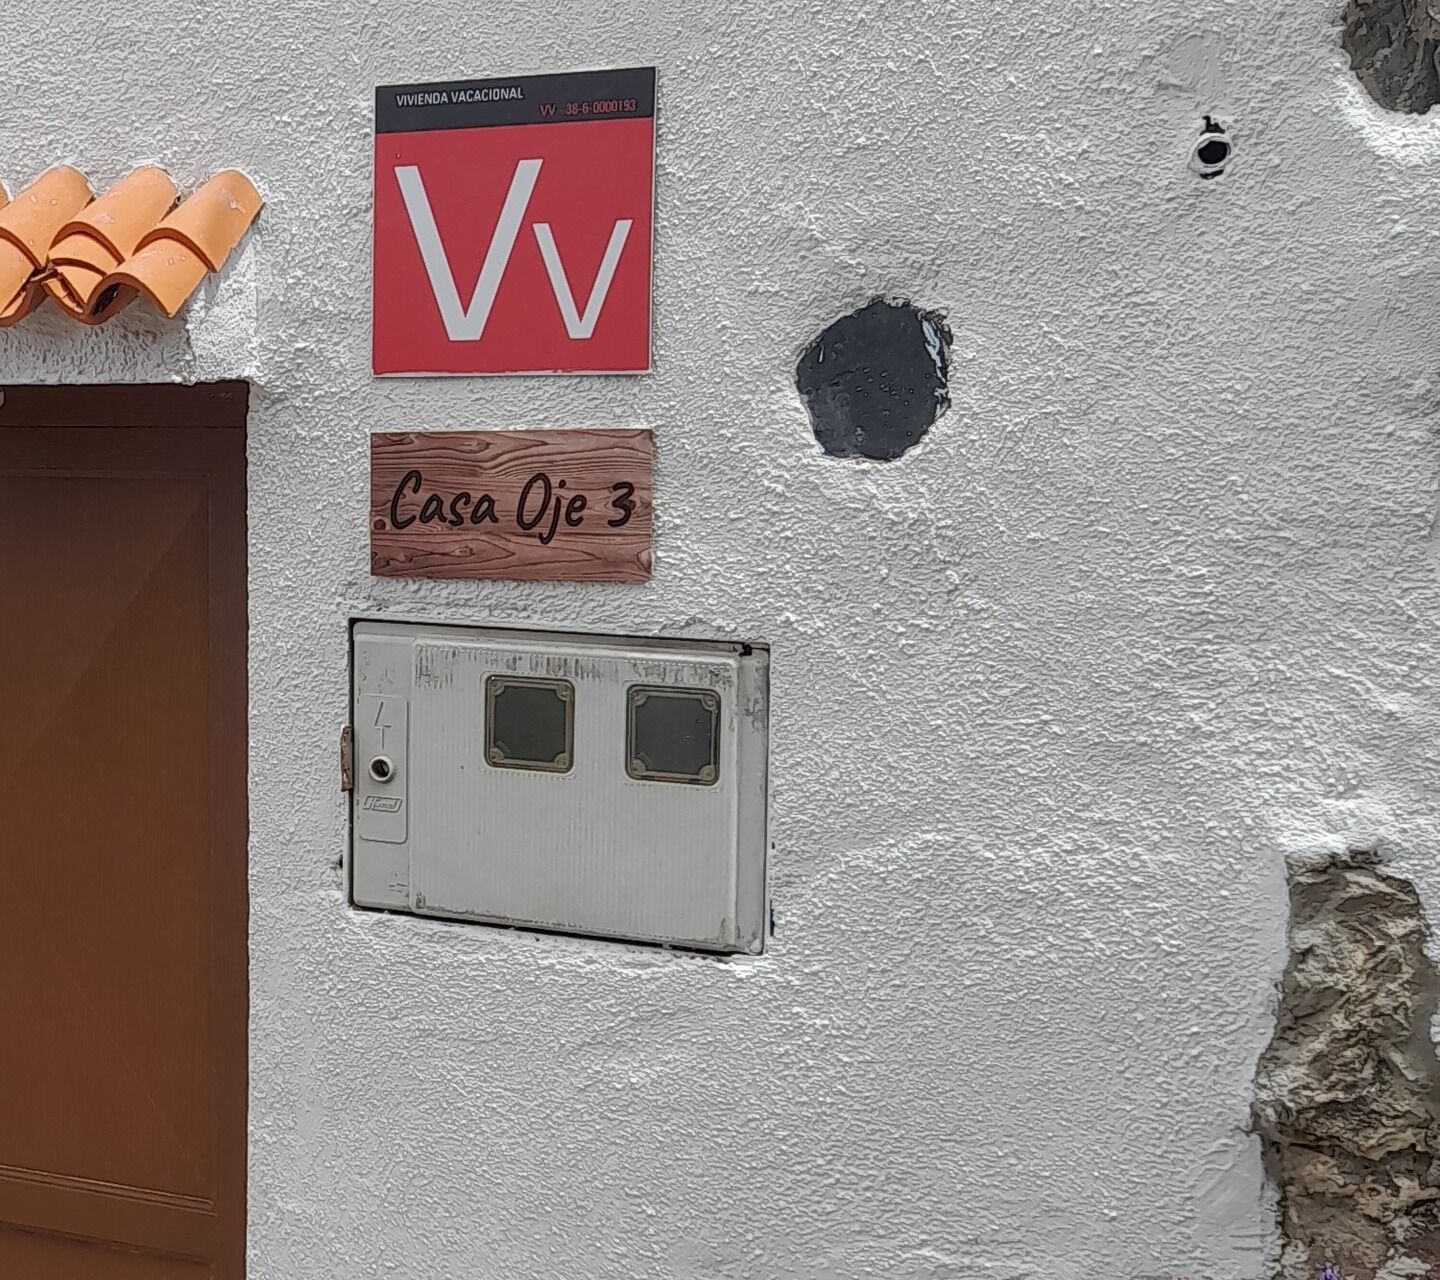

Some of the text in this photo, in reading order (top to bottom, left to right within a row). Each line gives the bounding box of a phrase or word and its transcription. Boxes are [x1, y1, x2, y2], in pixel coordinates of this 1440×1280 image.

[396, 87, 524, 107] VIVIENDA VACACIONAL
[390, 470, 635, 544] Casa Oje 3
